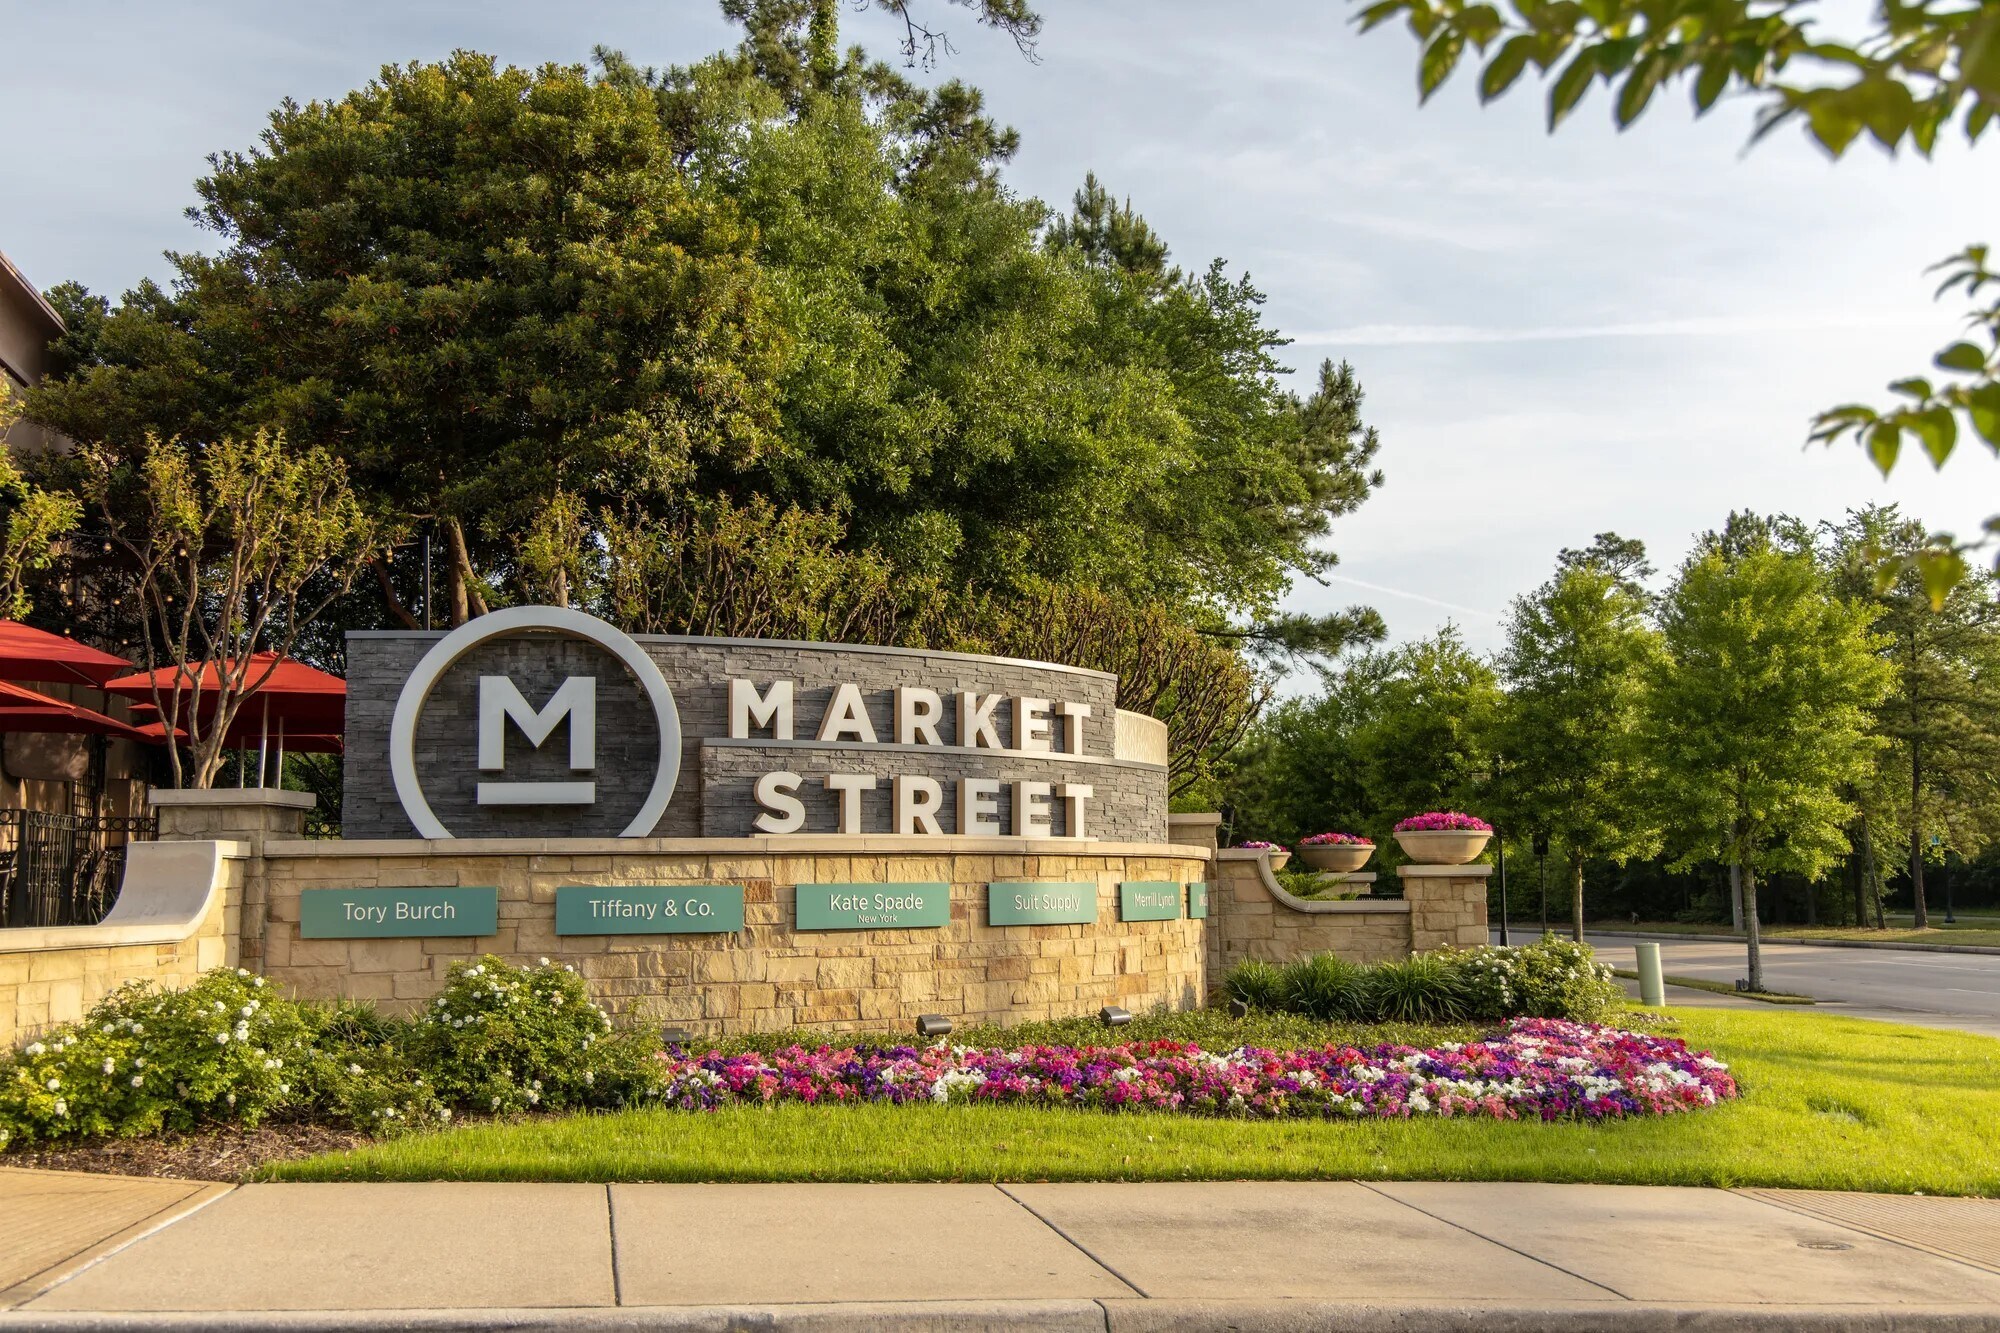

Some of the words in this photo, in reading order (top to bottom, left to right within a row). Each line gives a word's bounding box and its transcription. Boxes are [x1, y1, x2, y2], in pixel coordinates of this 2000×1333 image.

[478, 675, 596, 770] M
[728, 678, 1091, 756] MARKET
[753, 771, 1094, 839] STREET
[589, 900, 657, 919] Tiffany
[664, 900, 679, 916] &
[685, 899, 716, 917] Co.
[829, 893, 869, 912] Kate
[874, 892, 924, 914] Spade
[1014, 893, 1038, 911] Suit
[1043, 893, 1081, 914] Supply
[1134, 892, 1157, 908] Merrill
[1158, 892, 1175, 909] Lynch
[343, 903, 387, 924] Tory
[395, 901, 456, 920] Burch
[858, 914, 877, 924] New
[879, 914, 898, 924] York
